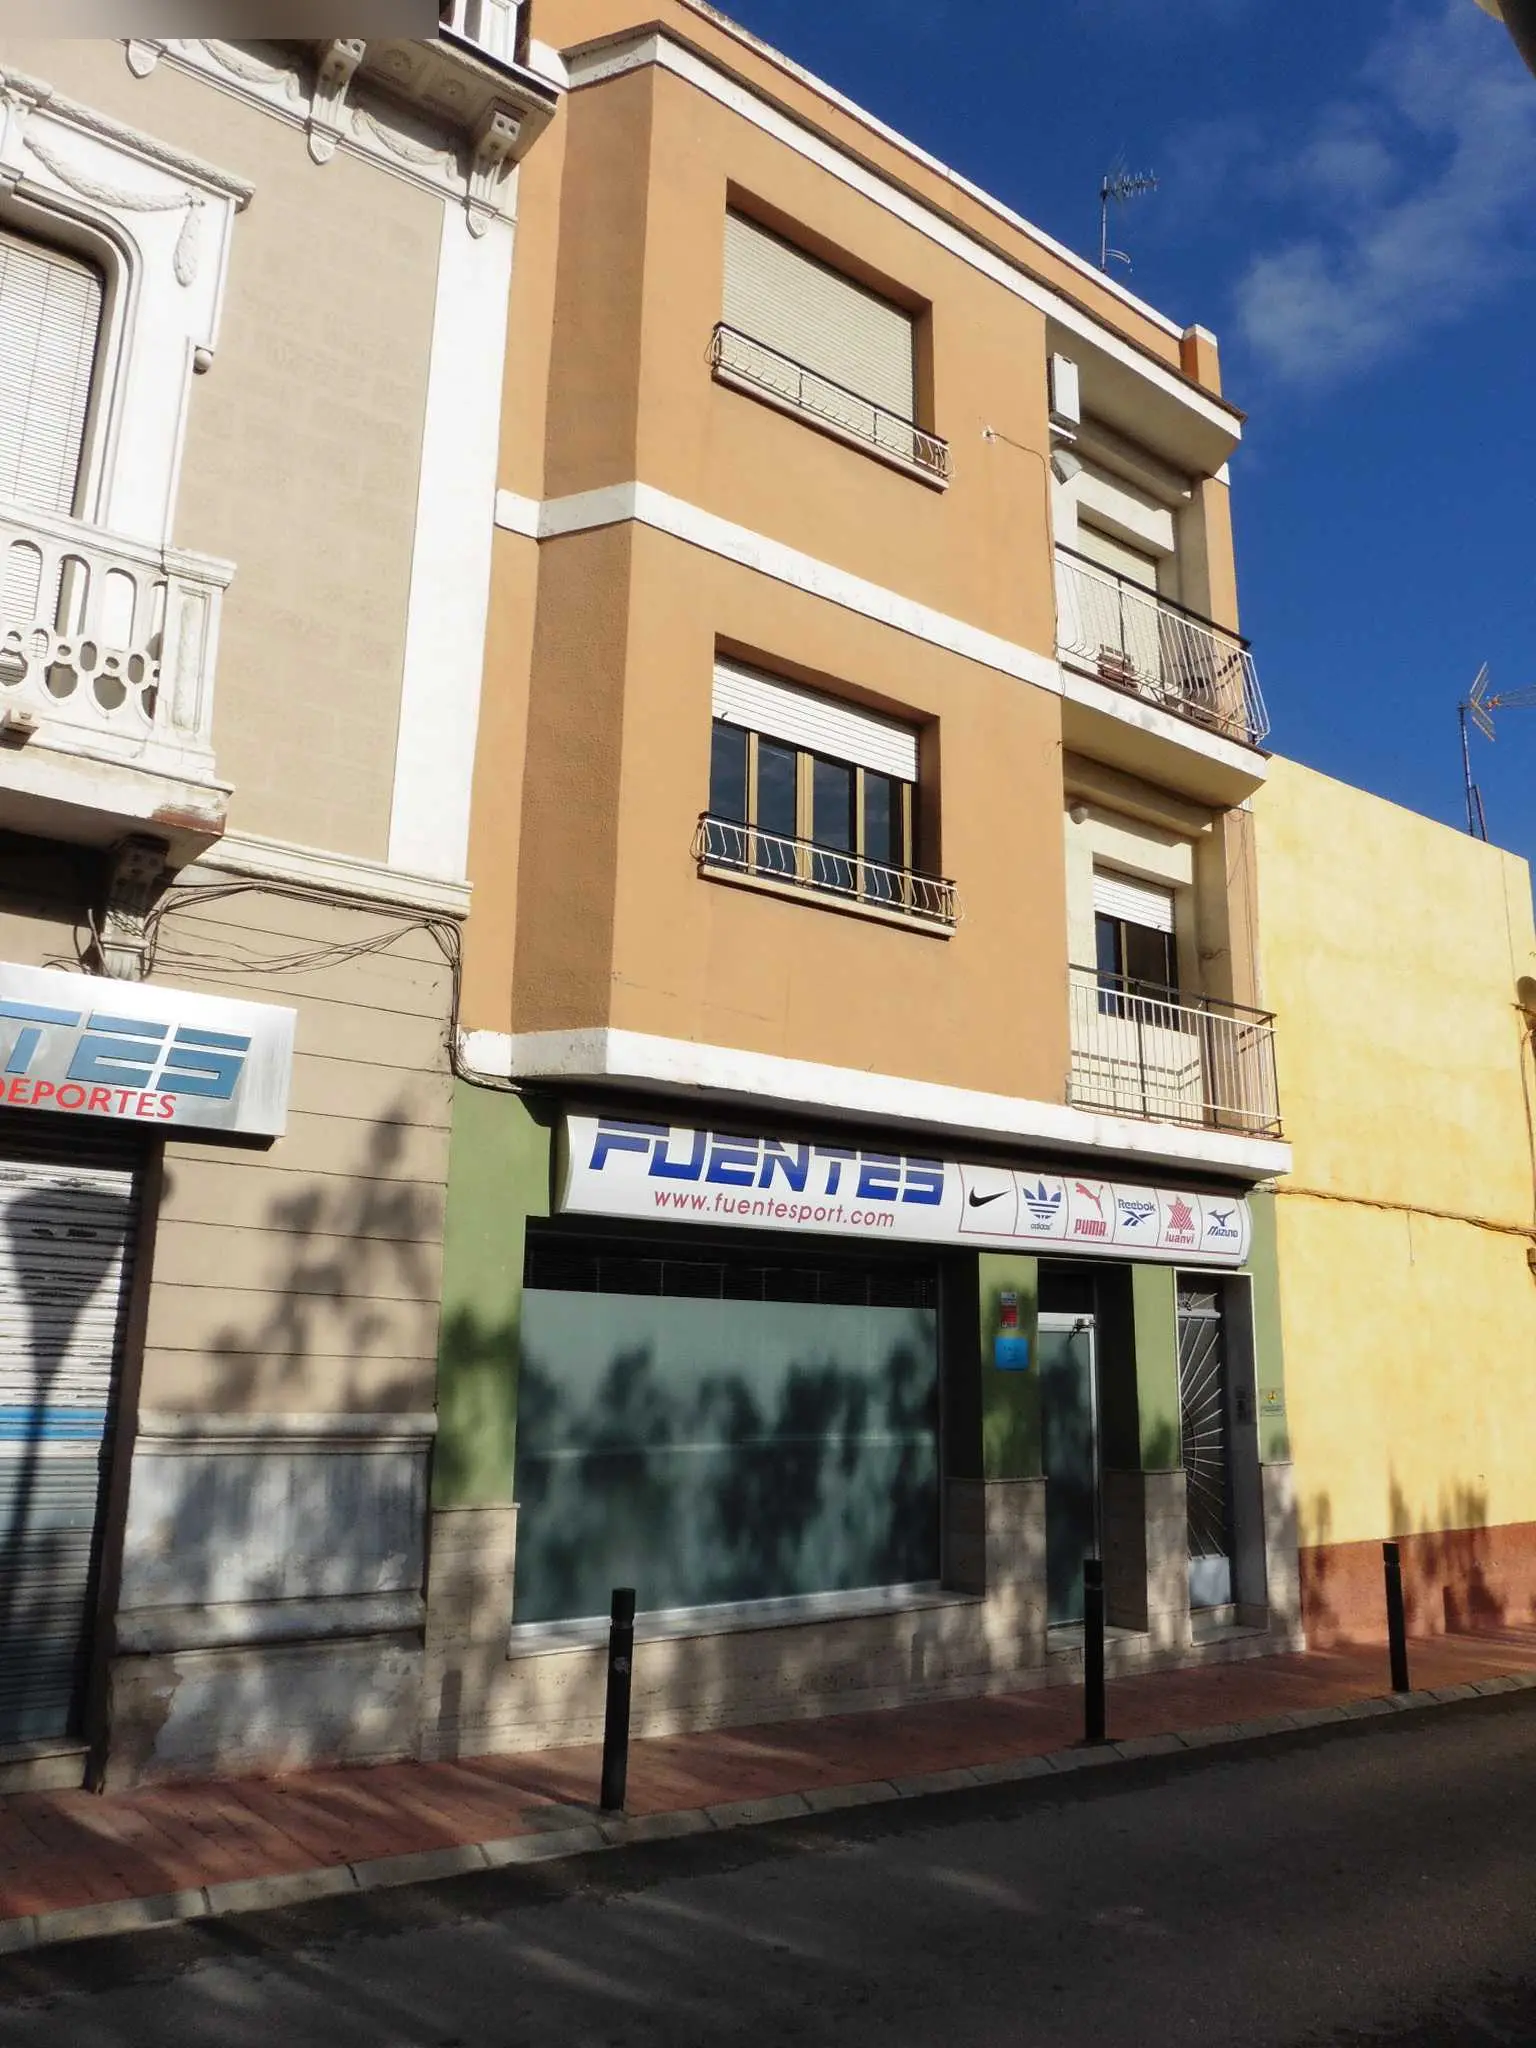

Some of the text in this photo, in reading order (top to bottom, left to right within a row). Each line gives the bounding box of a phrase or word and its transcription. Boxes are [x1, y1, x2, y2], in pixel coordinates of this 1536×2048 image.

[0, 1077, 176, 1119] EPORTES
[589, 1119, 944, 1206] FUENTES
[654, 1190, 895, 1229] www.fuentesport.com
[1118, 1198, 1156, 1212] Reebok
[1074, 1218, 1106, 1237] PUMA
